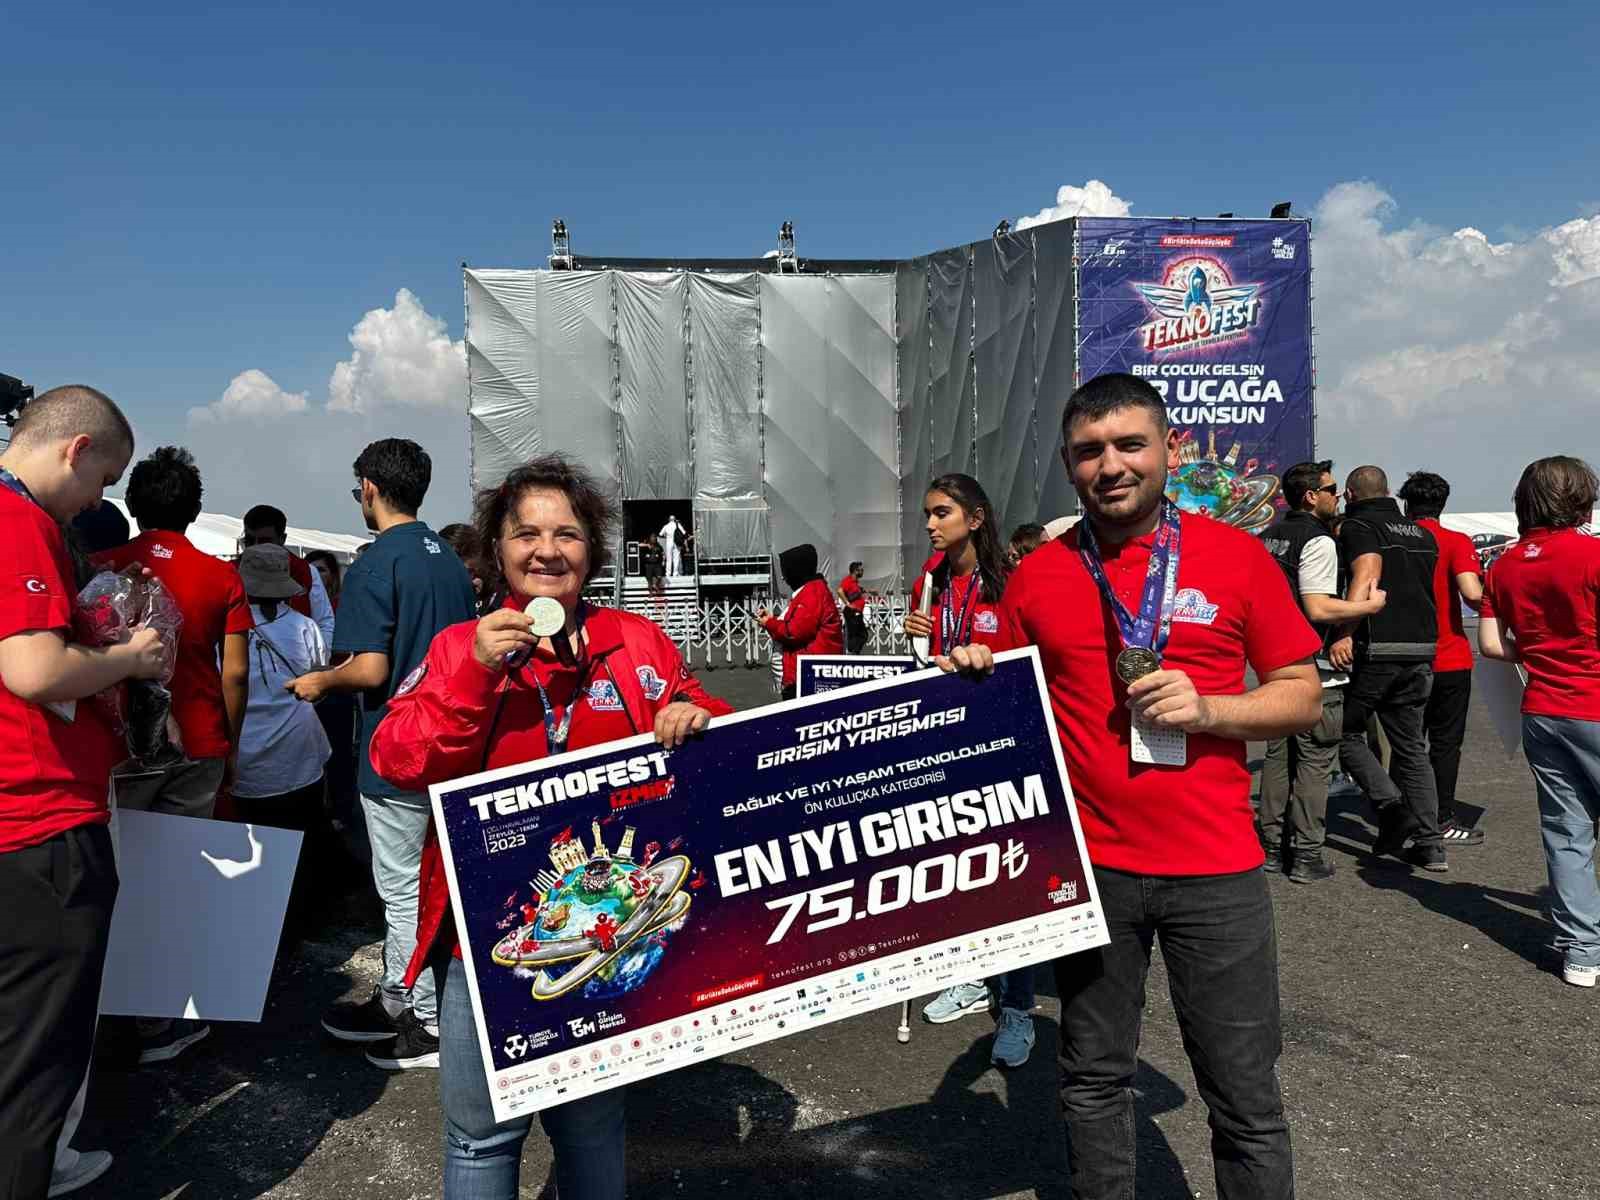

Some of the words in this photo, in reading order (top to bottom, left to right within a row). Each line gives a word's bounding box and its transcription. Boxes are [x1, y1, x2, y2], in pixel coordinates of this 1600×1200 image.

[1142, 298, 1259, 349] TEKNOFEST
[1160, 364, 1211, 378] ÇOCUK
[1212, 364, 1264, 376] GELSİN
[1176, 376, 1284, 406] UÇAĞA
[1167, 407, 1265, 424] KUNSUN
[812, 664, 904, 679] TEKNOFEST
[757, 735, 840, 770] GİRİŞİM
[847, 706, 967, 749] YARIŞMASI
[795, 699, 922, 742] TEKNOFEST
[469, 751, 671, 821] TEKNOFEST
[722, 793, 784, 817] SAĞLIK
[785, 786, 810, 800] VE
[811, 780, 832, 795] İYİ
[833, 766, 895, 789] YAŞAM
[896, 736, 1016, 773] TEKNOLOJİLERİ
[804, 800, 821, 815] ÖN
[824, 788, 880, 810] KULUÇKA
[881, 769, 947, 795] KATEGORİSİ
[488, 834, 527, 853] 2023
[714, 839, 787, 898] EN
[790, 820, 858, 878] İYİ
[860, 773, 1050, 858] GİRİŞİM
